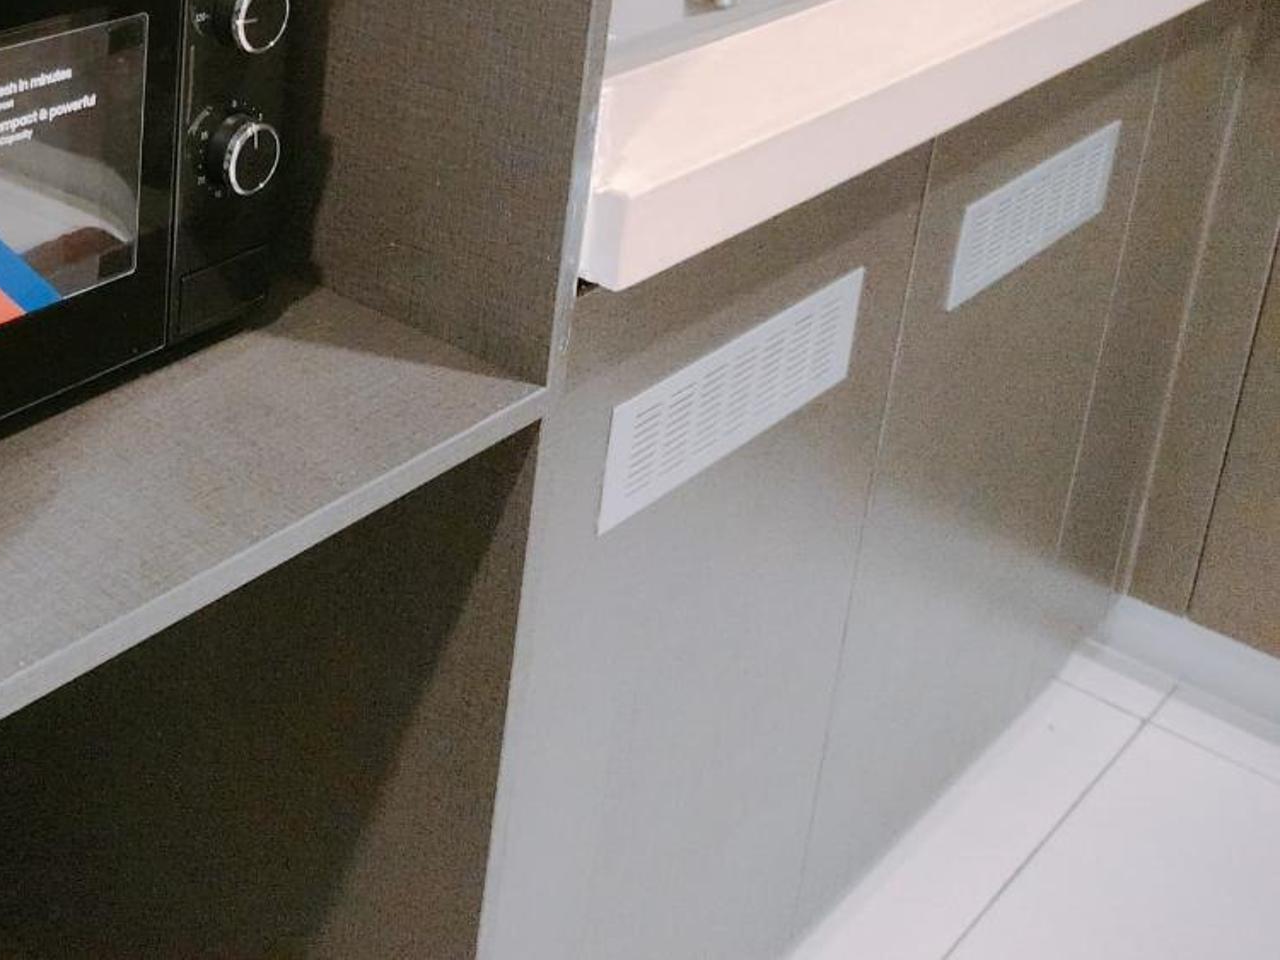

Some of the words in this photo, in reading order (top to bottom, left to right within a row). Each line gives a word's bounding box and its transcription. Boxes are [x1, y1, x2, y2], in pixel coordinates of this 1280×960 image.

[19, 78, 29, 92] in
[30, 67, 73, 89] minutes
[48, 92, 97, 122] powerful
